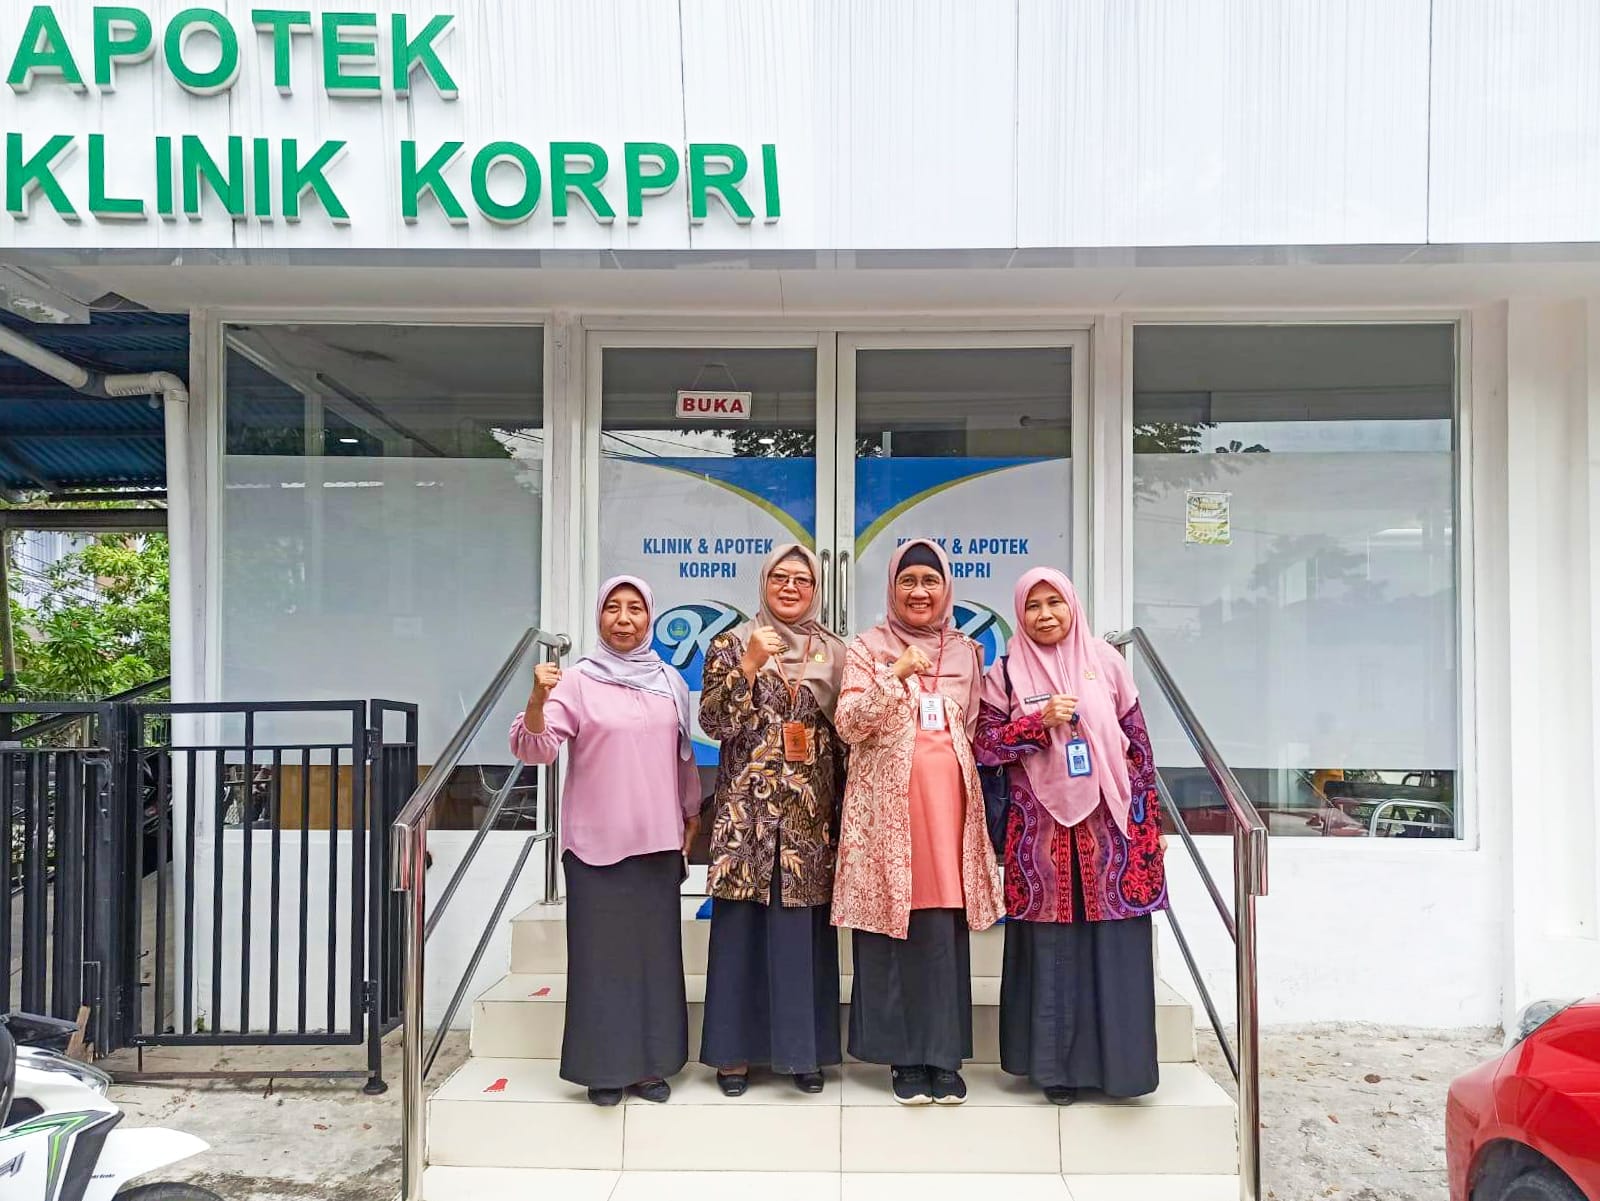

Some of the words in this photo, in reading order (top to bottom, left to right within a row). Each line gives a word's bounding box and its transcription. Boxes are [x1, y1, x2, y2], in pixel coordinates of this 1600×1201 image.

[6, 5, 458, 98] APOTEK
[6, 132, 350, 225] KLINIK
[400, 140, 781, 226] KORPRI
[682, 397, 744, 414] BUKA
[643, 538, 693, 554] KLINIK
[698, 538, 709, 554] &
[714, 538, 774, 554] APOTEK
[952, 538, 963, 554] &
[968, 538, 1029, 554] APOTEK
[679, 562, 737, 578] KORPRI
[948, 562, 991, 578] RPRI
